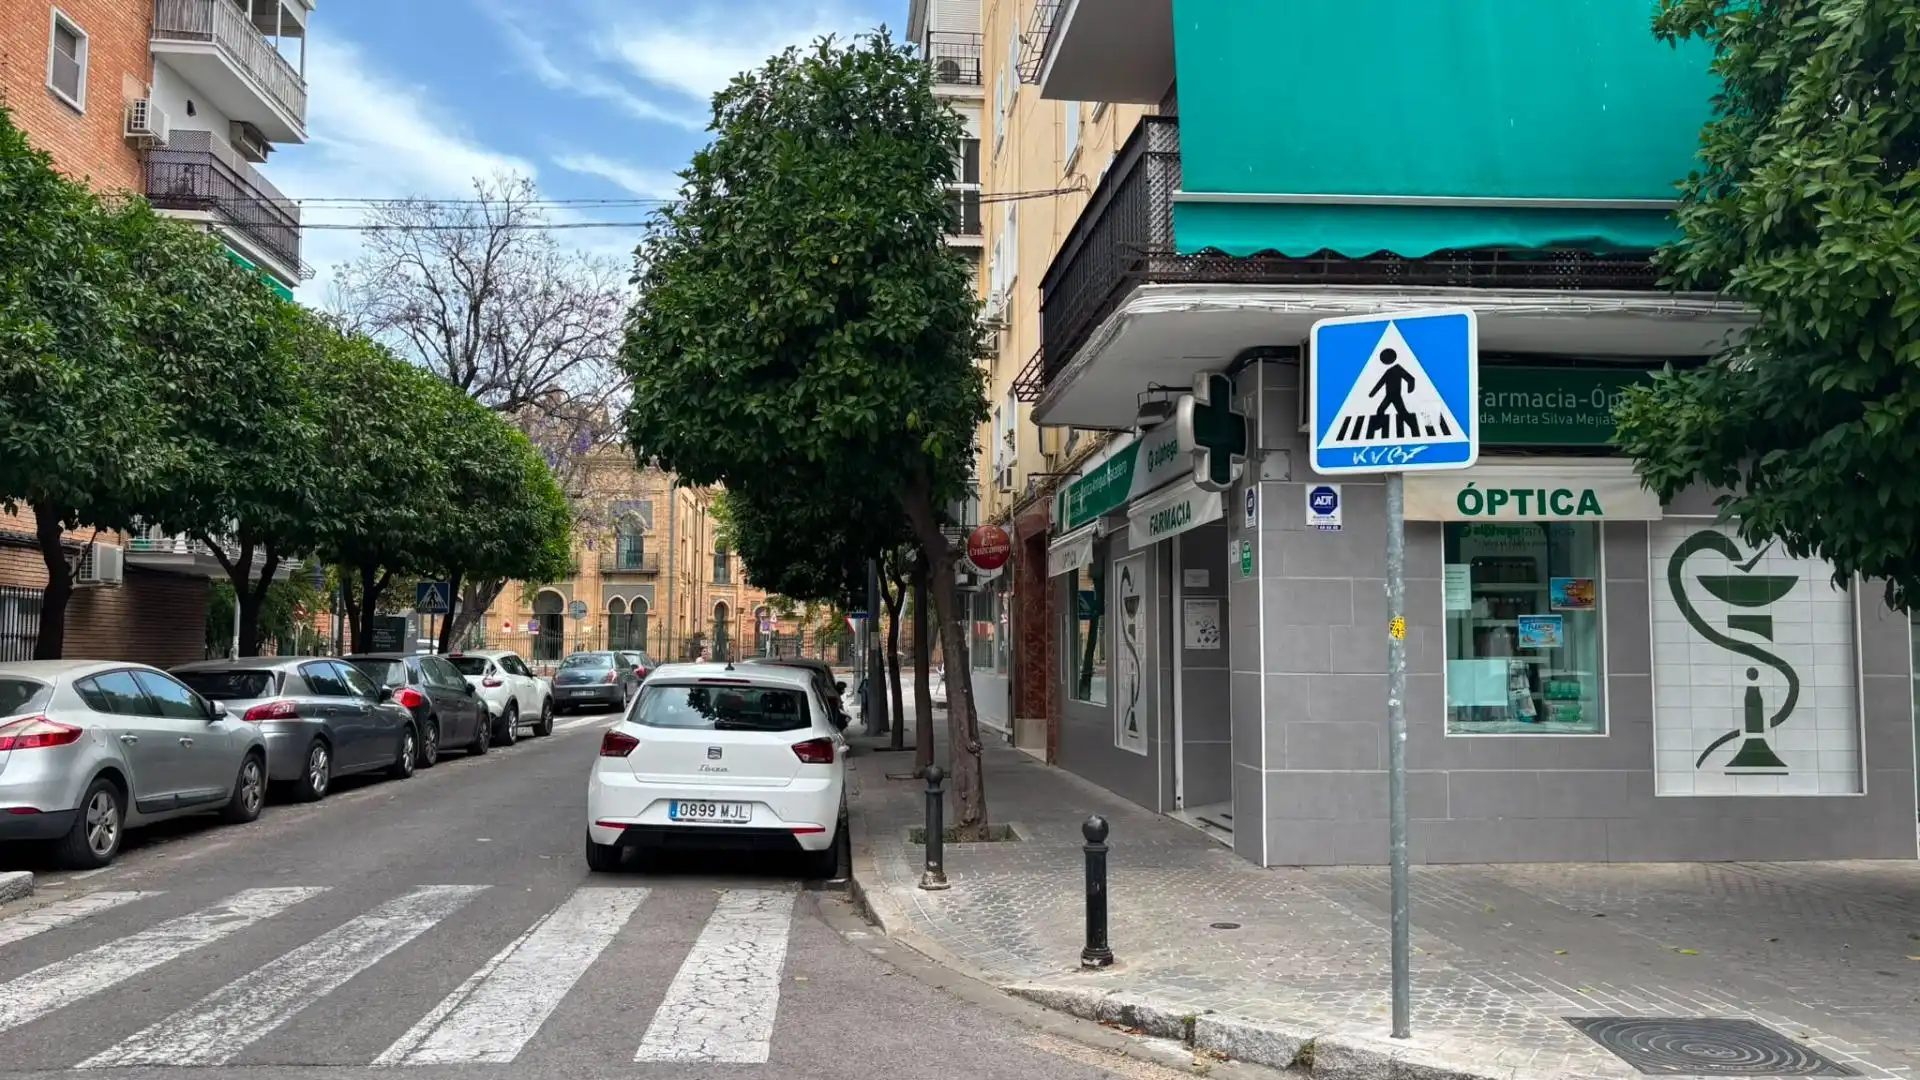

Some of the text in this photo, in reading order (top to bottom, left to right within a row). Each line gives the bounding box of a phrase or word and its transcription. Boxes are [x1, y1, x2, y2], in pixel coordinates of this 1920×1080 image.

[1478, 383, 1622, 409] armacia-Óp
[1501, 412, 1539, 424] Marta
[1541, 412, 1573, 425] Silva
[1576, 412, 1617, 427] Mejías
[1314, 495, 1334, 506] ADT
[1456, 482, 1604, 516] ÓPTICA
[1149, 500, 1191, 536] FARMACIA
[969, 545, 1009, 557] Cruzcampo
[698, 764, 729, 773] Ibiza
[679, 803, 747, 819] 0899 MJL
